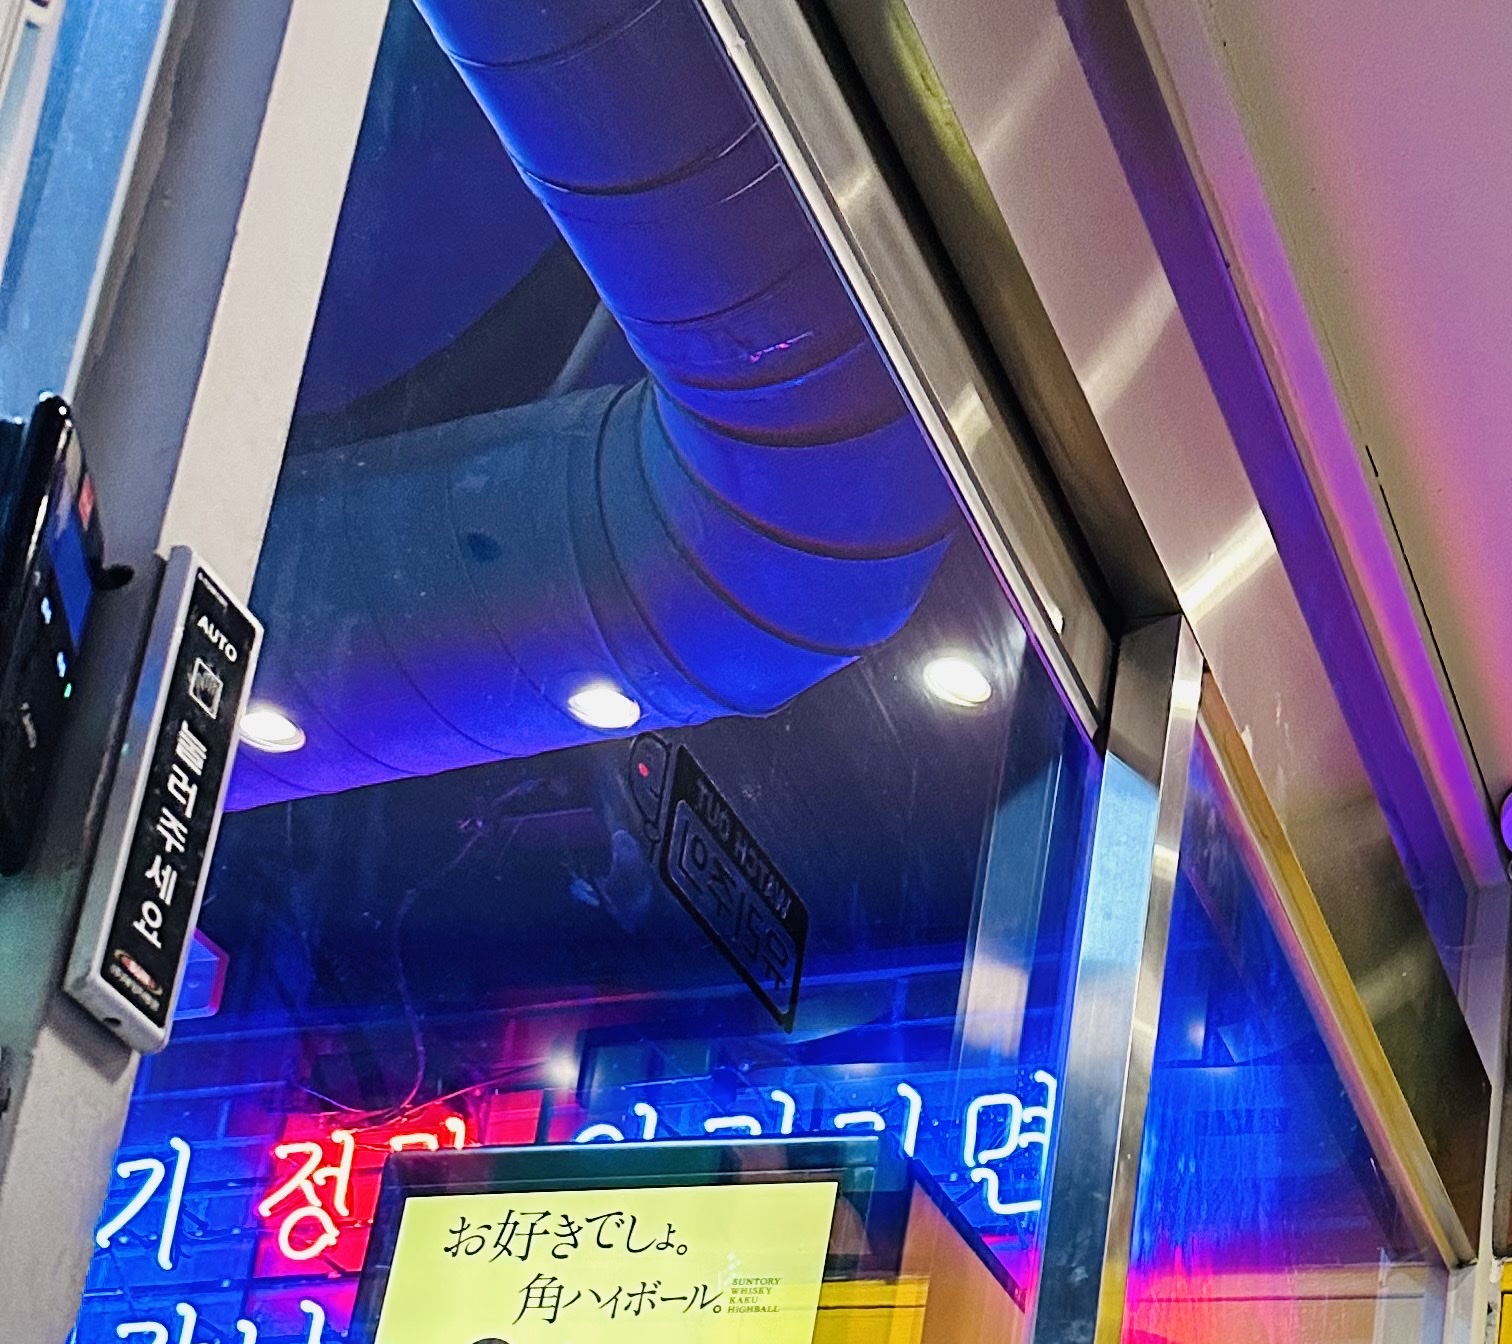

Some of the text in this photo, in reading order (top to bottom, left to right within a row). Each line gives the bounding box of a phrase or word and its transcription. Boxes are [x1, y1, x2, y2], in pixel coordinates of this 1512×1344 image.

[196, 615, 238, 662] AUTO
[133, 719, 208, 949] 눌러주세요
[443, 1208, 689, 1263] お好きでしょ。
[730, 1286, 773, 1295] WHISKY
[731, 1277, 782, 1286] SUNTORY
[511, 1272, 724, 1325] 角ハイボール。
[727, 1305, 780, 1314] HIGHBALL
[728, 1296, 759, 1305] KAKU
